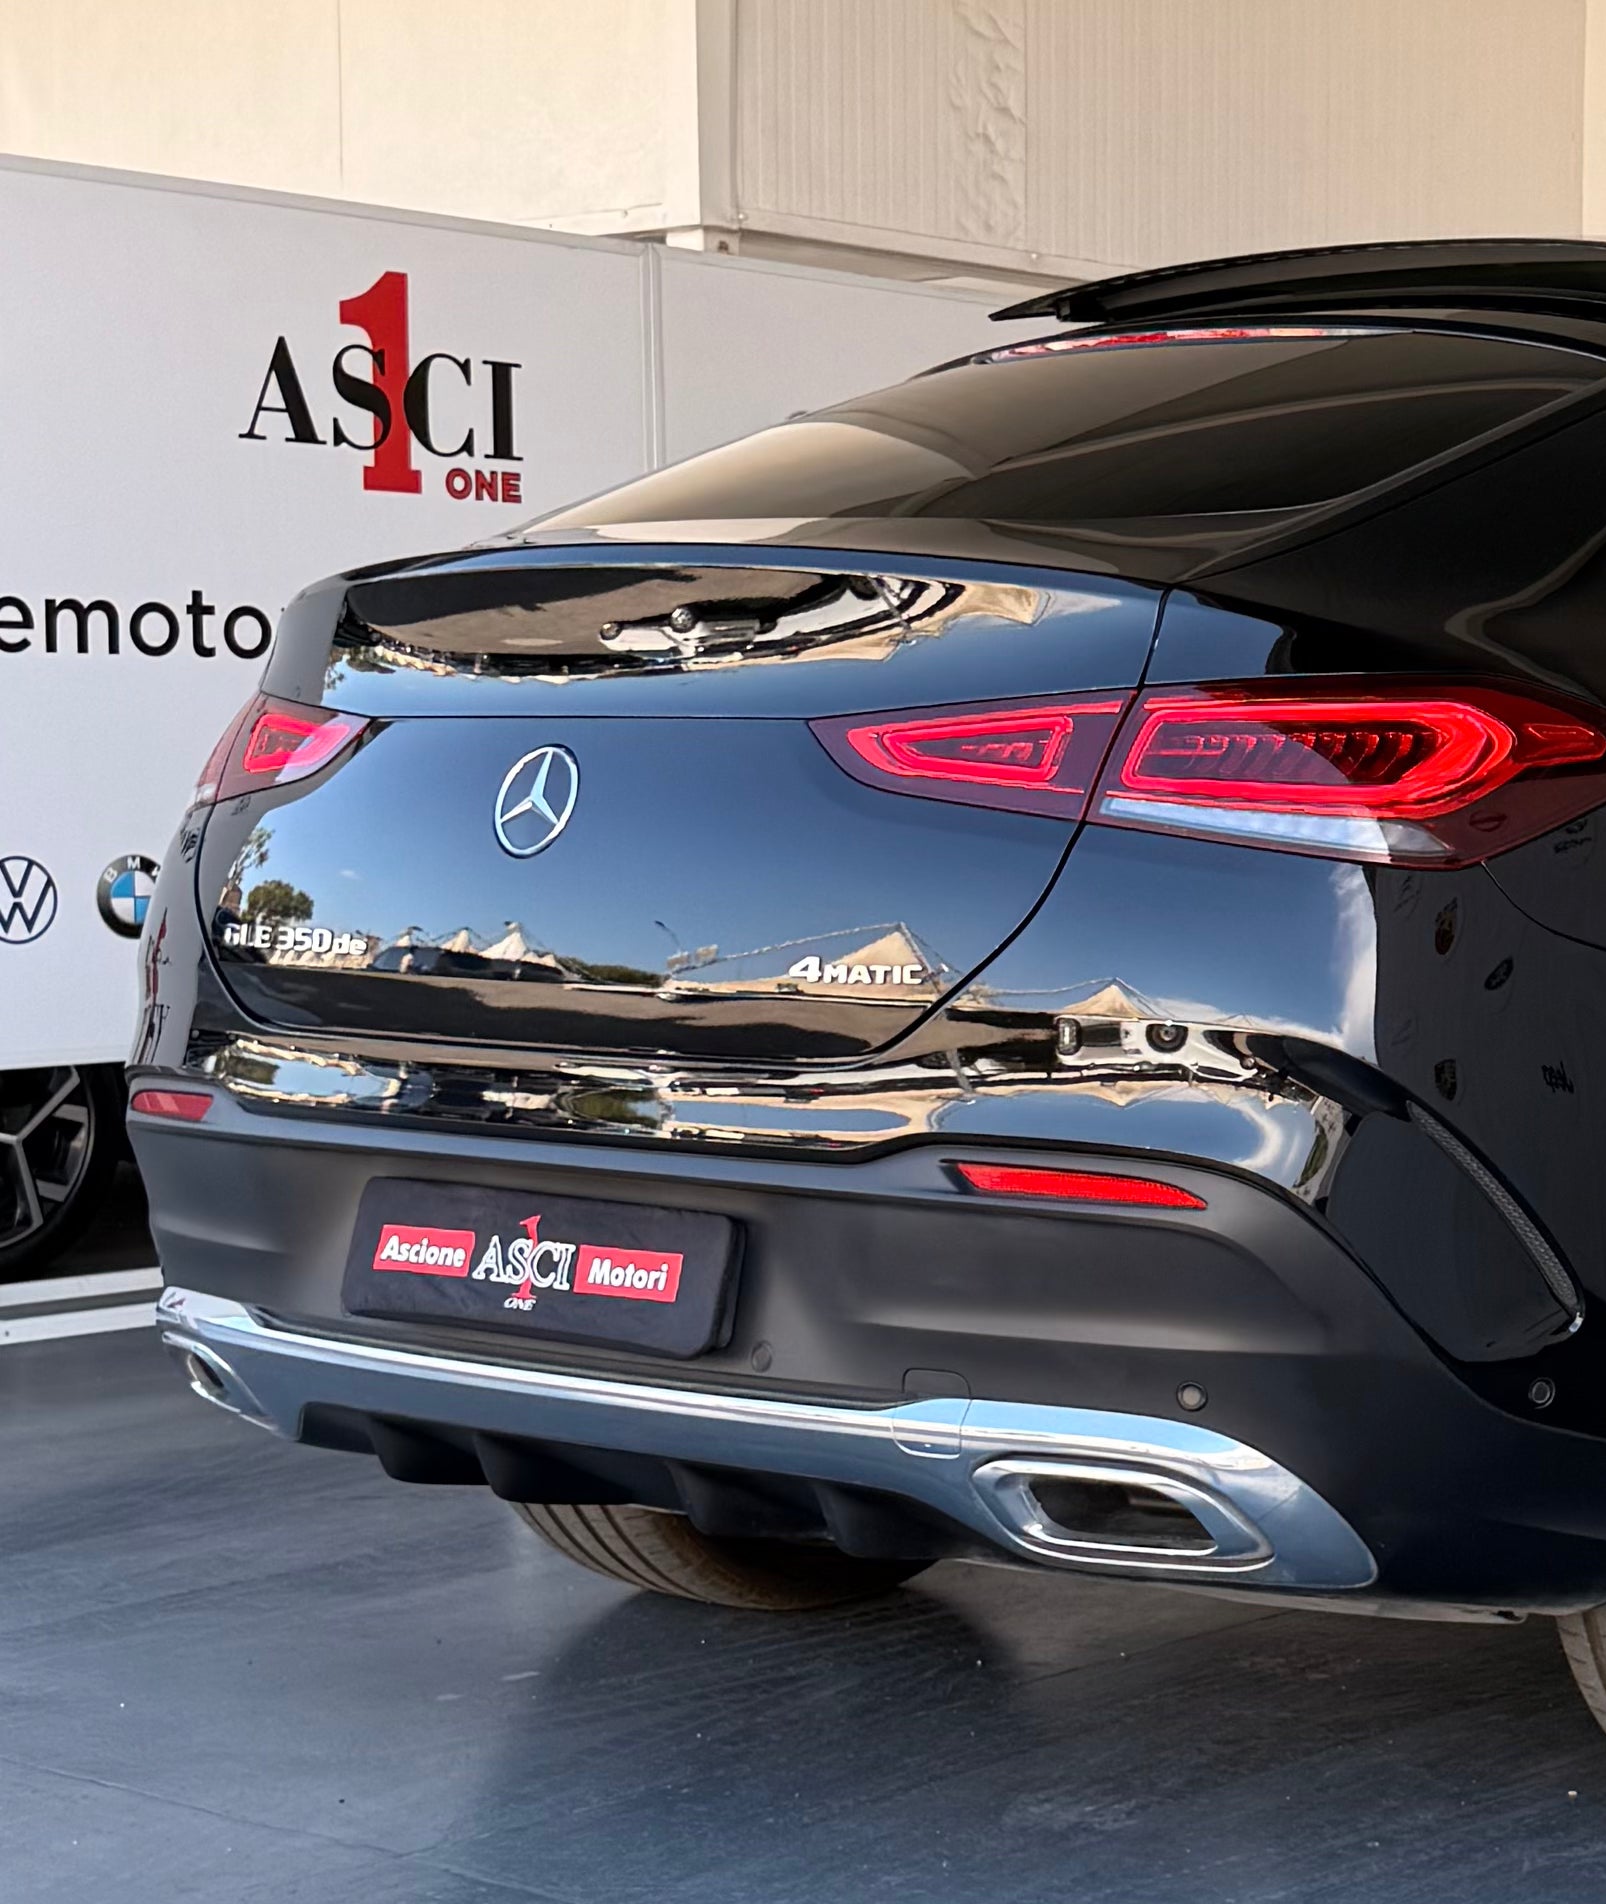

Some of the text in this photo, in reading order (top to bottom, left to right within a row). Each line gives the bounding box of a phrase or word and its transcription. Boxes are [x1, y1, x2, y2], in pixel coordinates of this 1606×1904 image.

[239, 336, 523, 462] ASCI
[445, 467, 523, 503] ONE
[0, 590, 285, 659] emoto
[224, 923, 272, 949] GLE
[788, 956, 923, 985] 4MATIC
[380, 1234, 669, 1291] Ascione ASCI Motori
[504, 1297, 536, 1312] ONE
